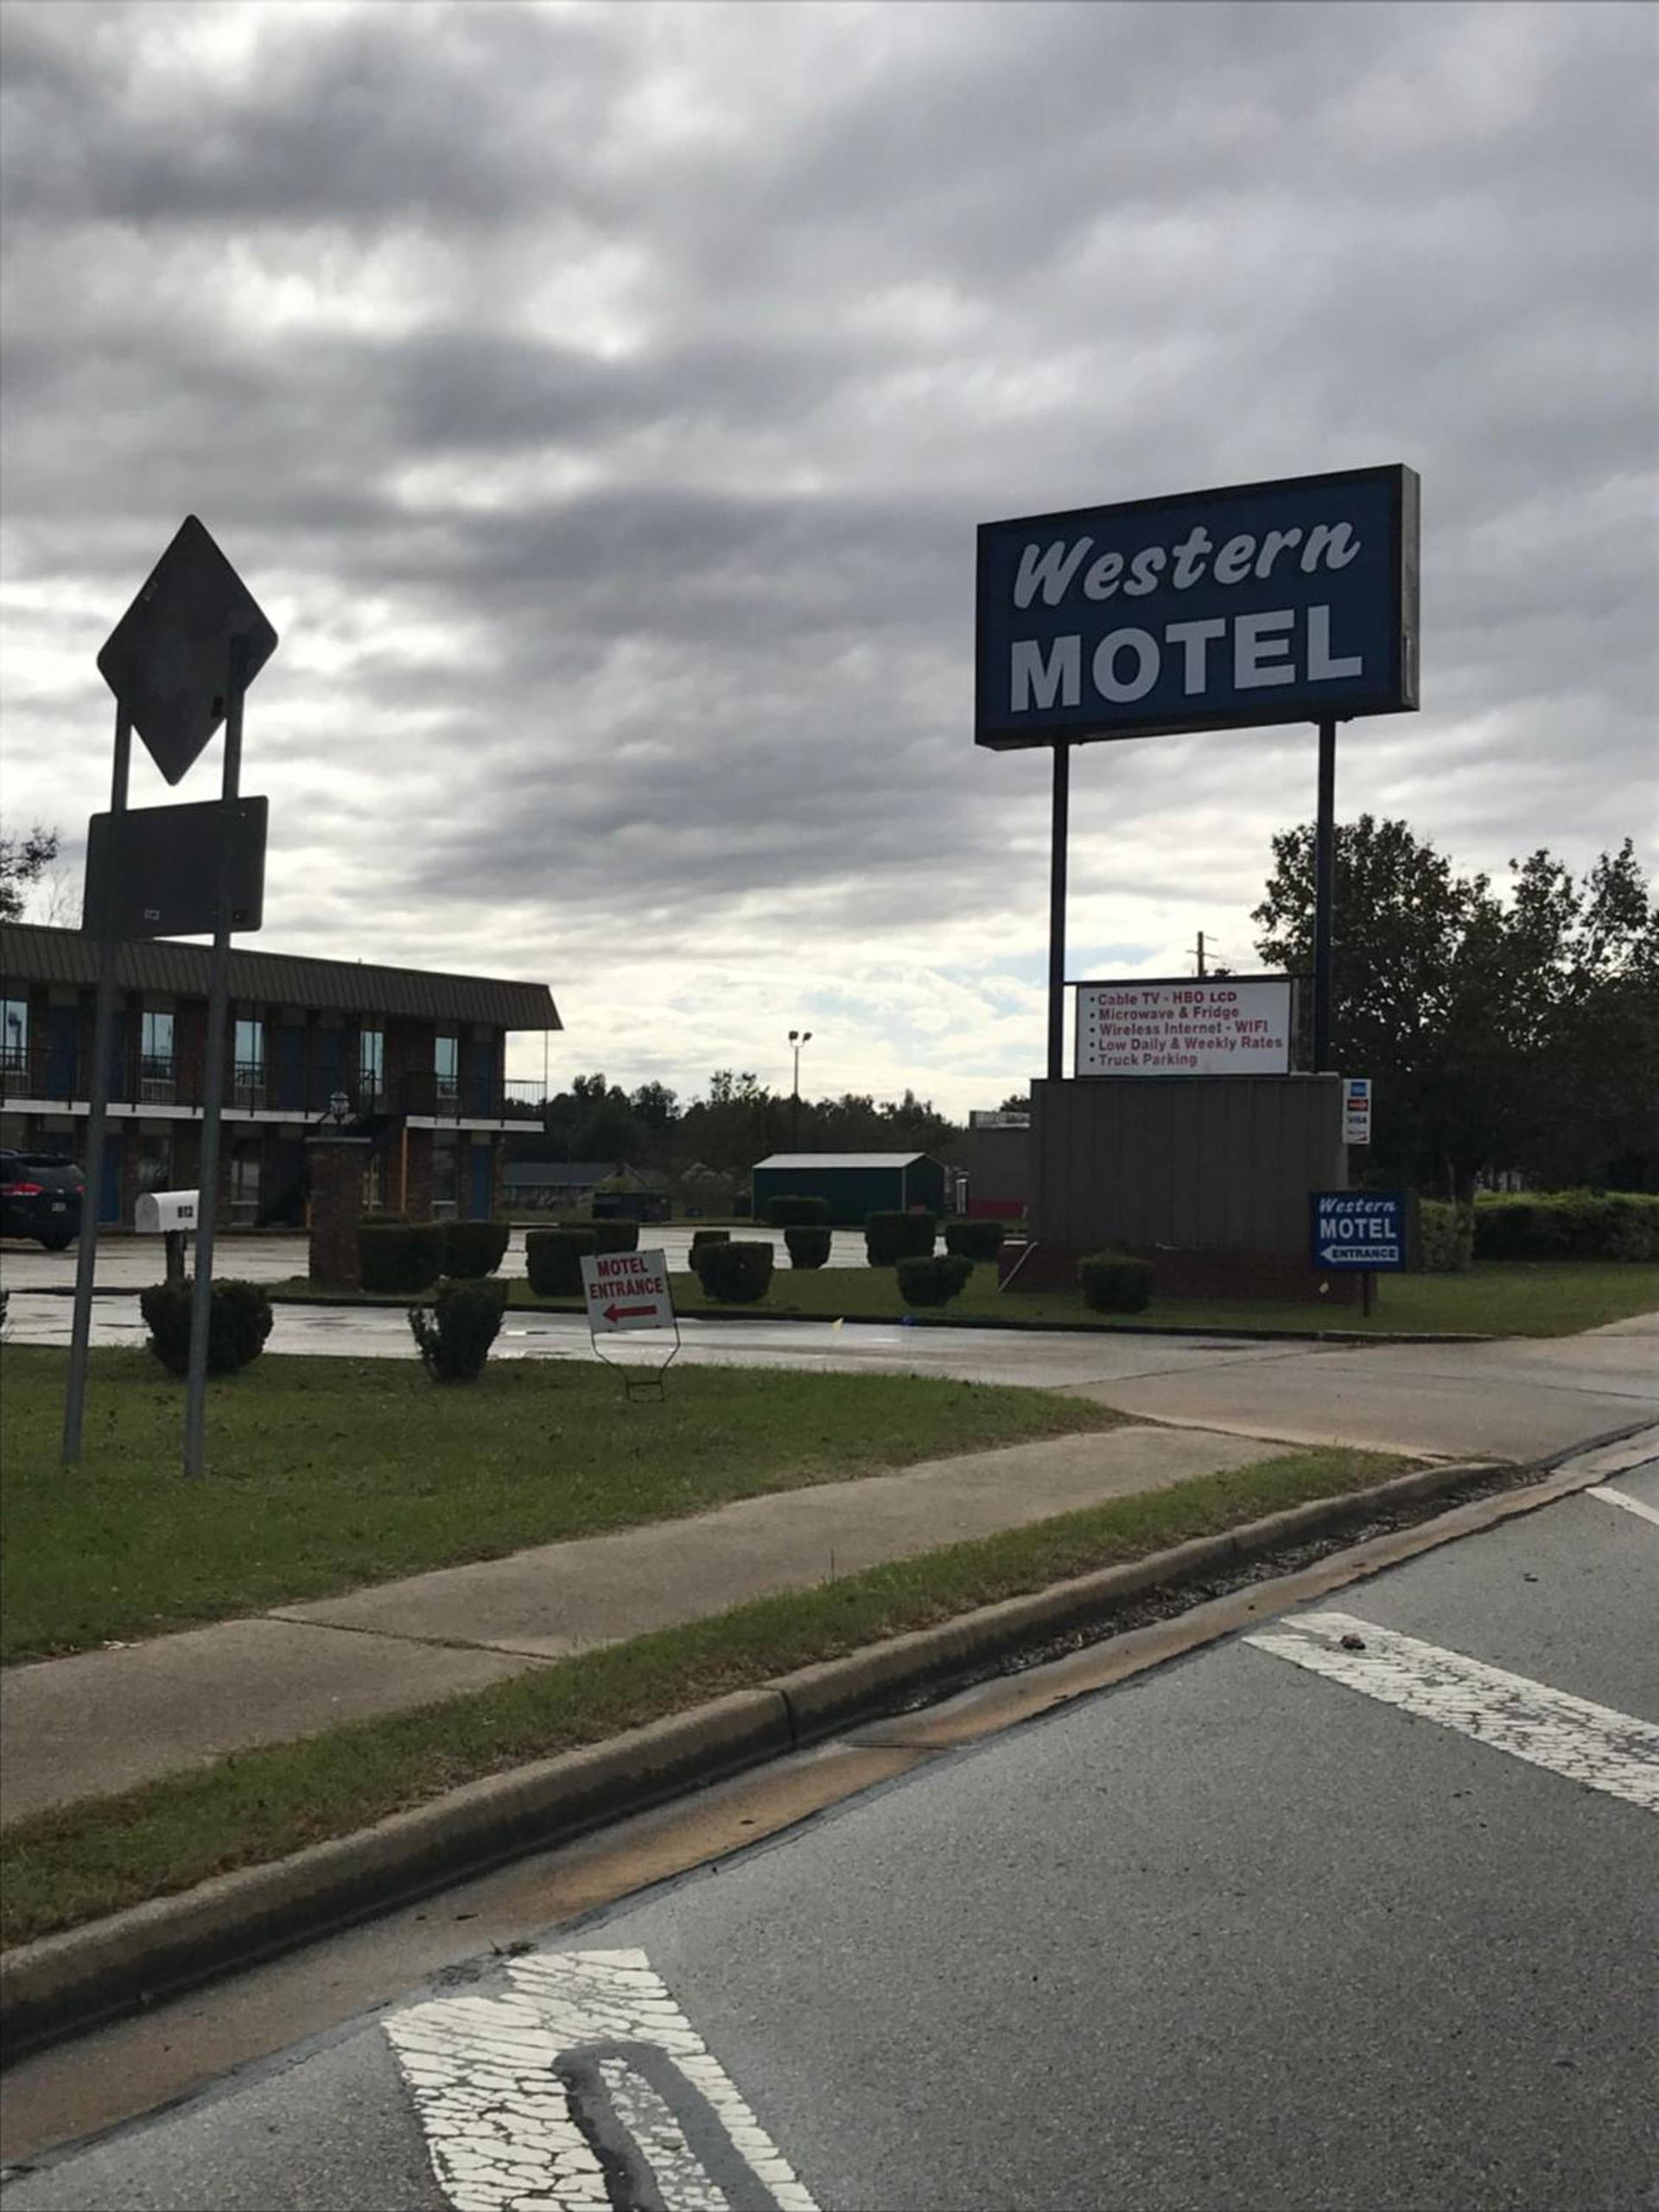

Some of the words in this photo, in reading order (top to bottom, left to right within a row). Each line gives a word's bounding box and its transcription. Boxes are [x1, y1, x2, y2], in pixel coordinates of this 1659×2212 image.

[1014, 521, 1361, 608] Western
[1011, 605, 1363, 712] MOTEL
[1098, 994, 1138, 1006] Cable
[1142, 991, 1160, 1004] TV
[1173, 991, 1205, 1003] HBO
[1211, 991, 1237, 1002] LCD
[1099, 1007, 1174, 1020] Microwave
[1179, 1006, 1188, 1019] &
[1193, 1005, 1239, 1020] Fridge
[1099, 1023, 1160, 1036] Wireless
[1165, 1020, 1222, 1034] Internet
[1098, 1039, 1126, 1052] Low
[1131, 1037, 1166, 1052] Daily
[1170, 1038, 1179, 1050] &
[1185, 1036, 1236, 1051] Weekly
[1241, 1035, 1283, 1049] Rates
[1099, 1053, 1139, 1066] Truck
[1143, 1052, 1198, 1067] Parking
[1319, 1198, 1395, 1213] Western
[1320, 1218, 1396, 1239] MOTEL
[1332, 1249, 1395, 1258] ENTRANCE
[597, 1257, 648, 1277] MOTEL
[589, 1277, 664, 1300] ENTRANCE
